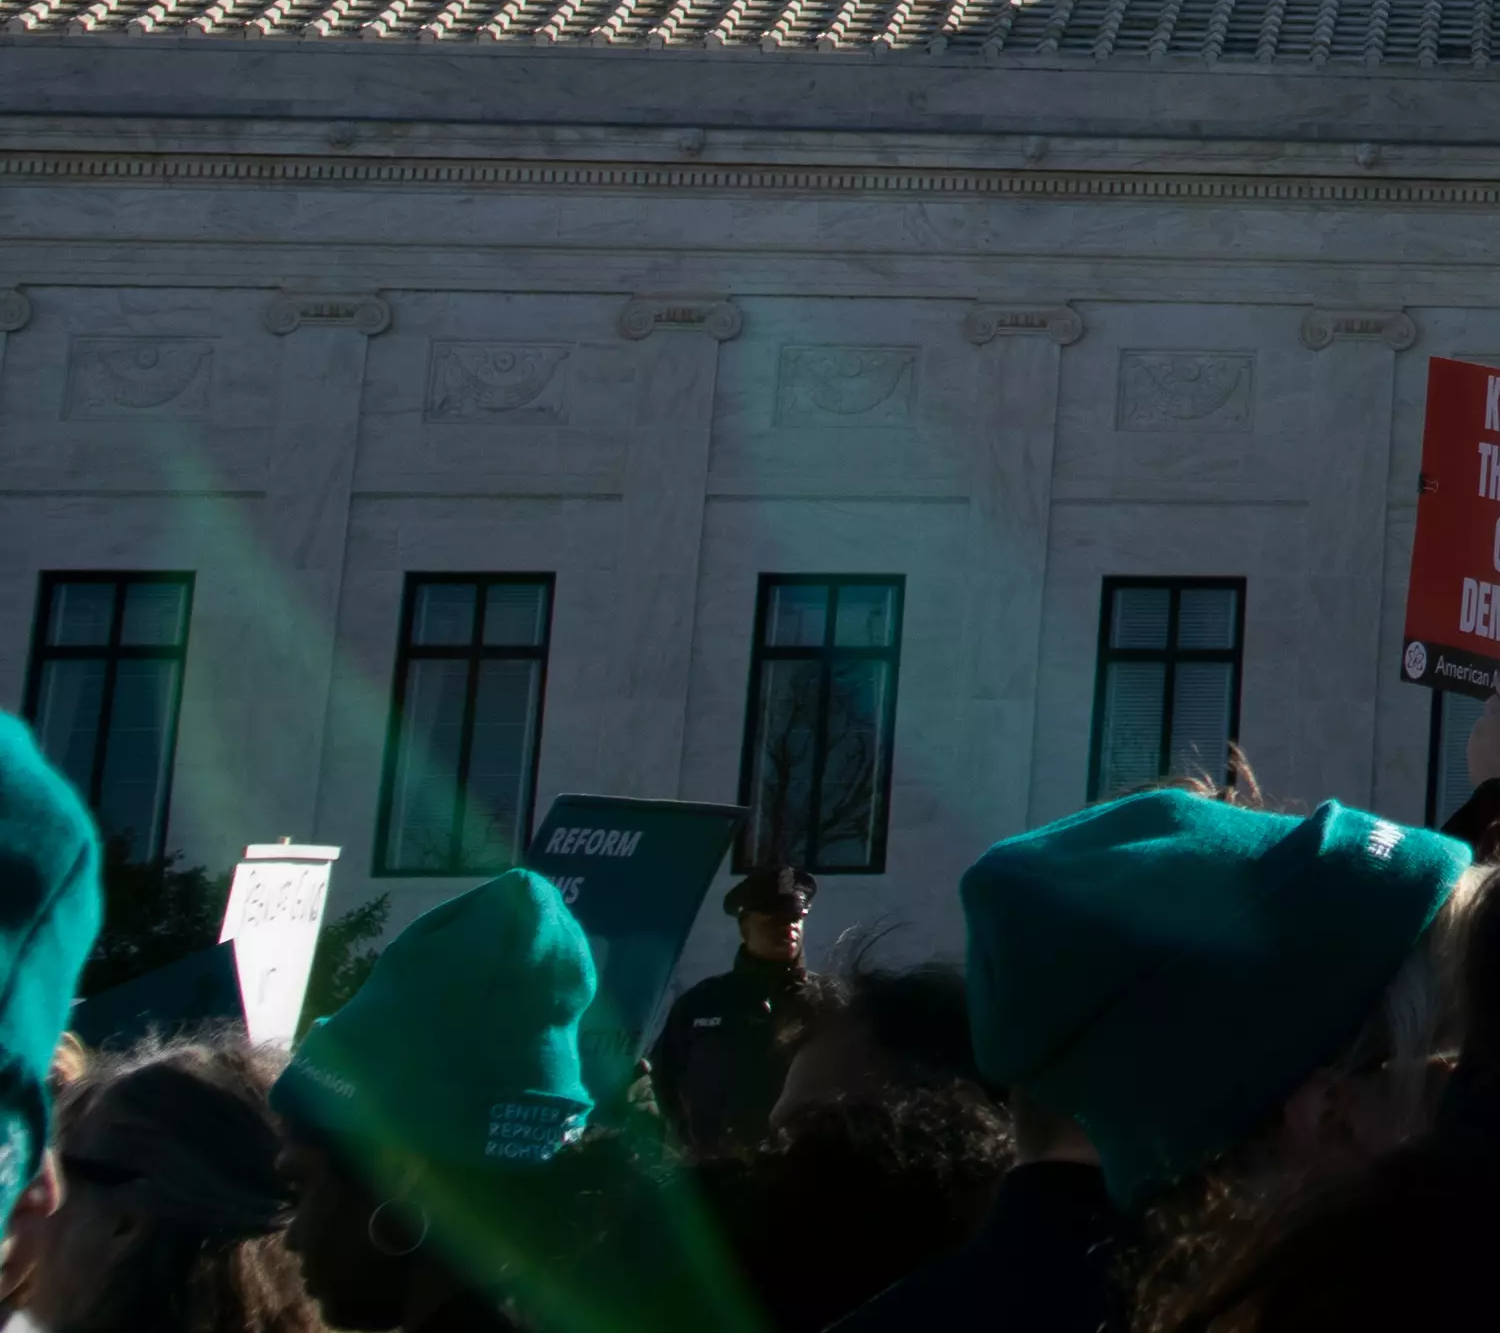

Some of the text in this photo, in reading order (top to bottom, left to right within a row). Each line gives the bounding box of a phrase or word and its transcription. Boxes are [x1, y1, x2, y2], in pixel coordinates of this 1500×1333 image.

[1435, 655, 1490, 686] American
[544, 827, 642, 857] REFORM
[490, 1102, 560, 1124] CENTER
